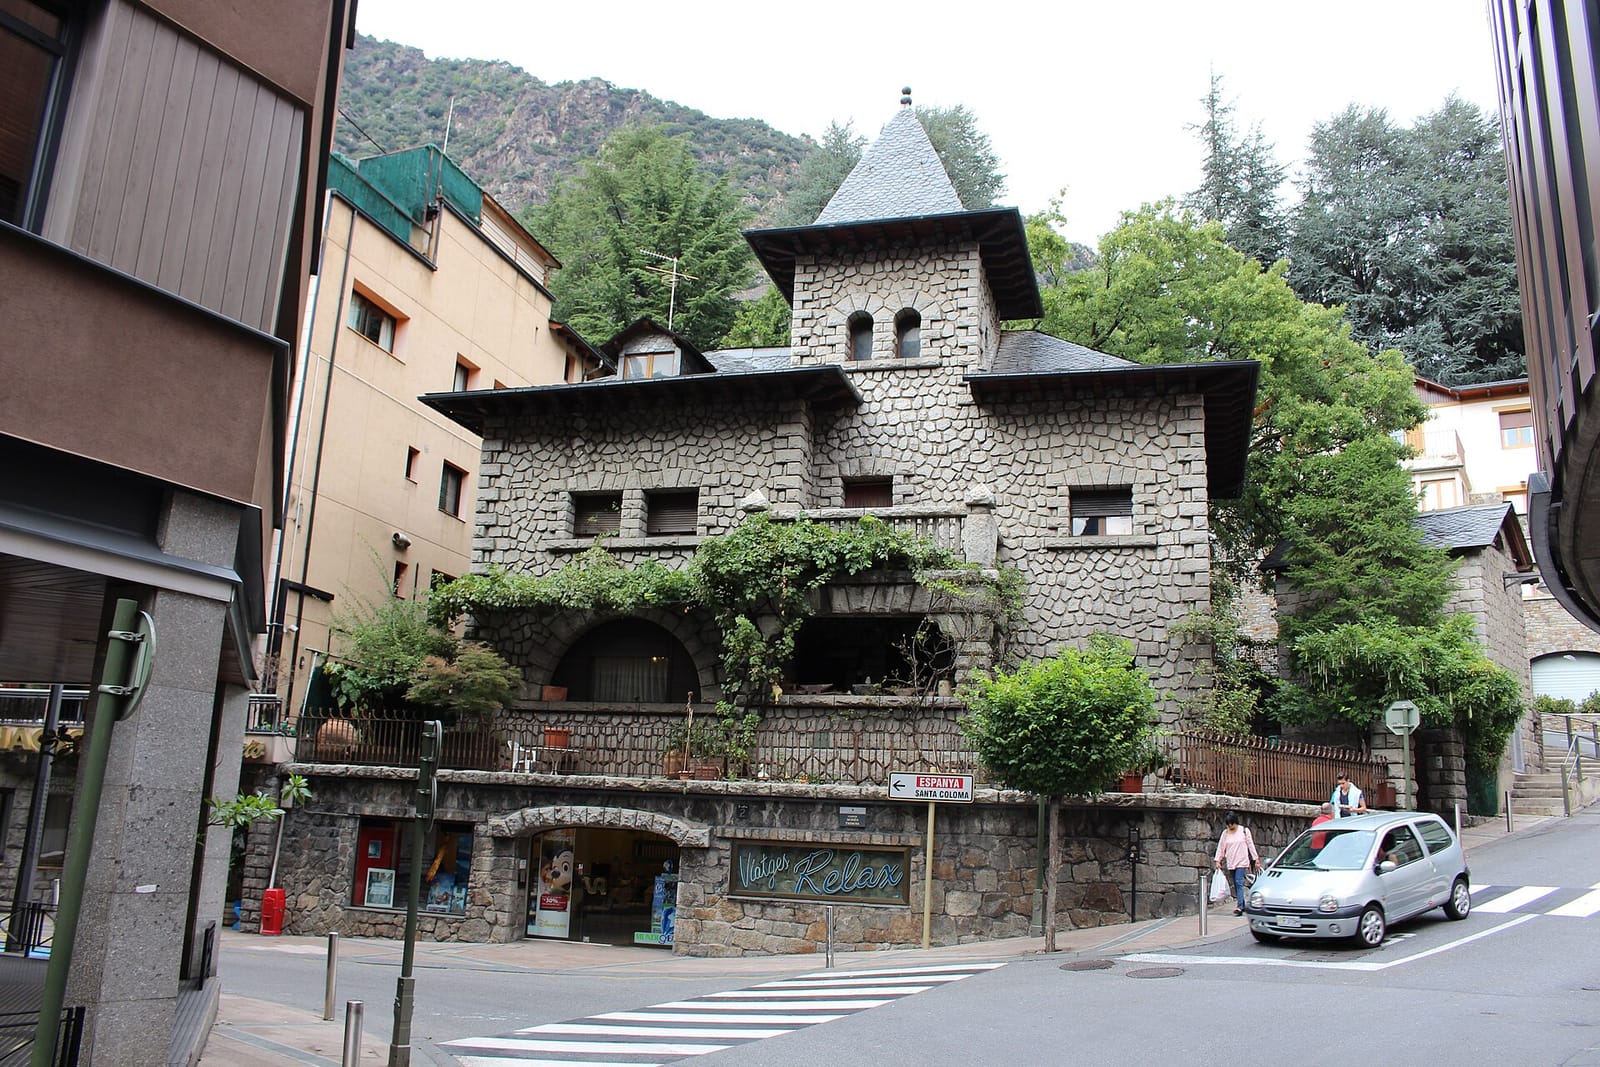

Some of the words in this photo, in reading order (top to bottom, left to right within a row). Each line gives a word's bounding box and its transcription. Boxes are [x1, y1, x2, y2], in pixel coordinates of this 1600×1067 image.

[919, 777, 960, 788] ESPANYA
[915, 789, 938, 798] SANTA
[939, 790, 970, 799] COLOMA
[739, 851, 790, 889] Viatges
[794, 849, 904, 895] Relax
